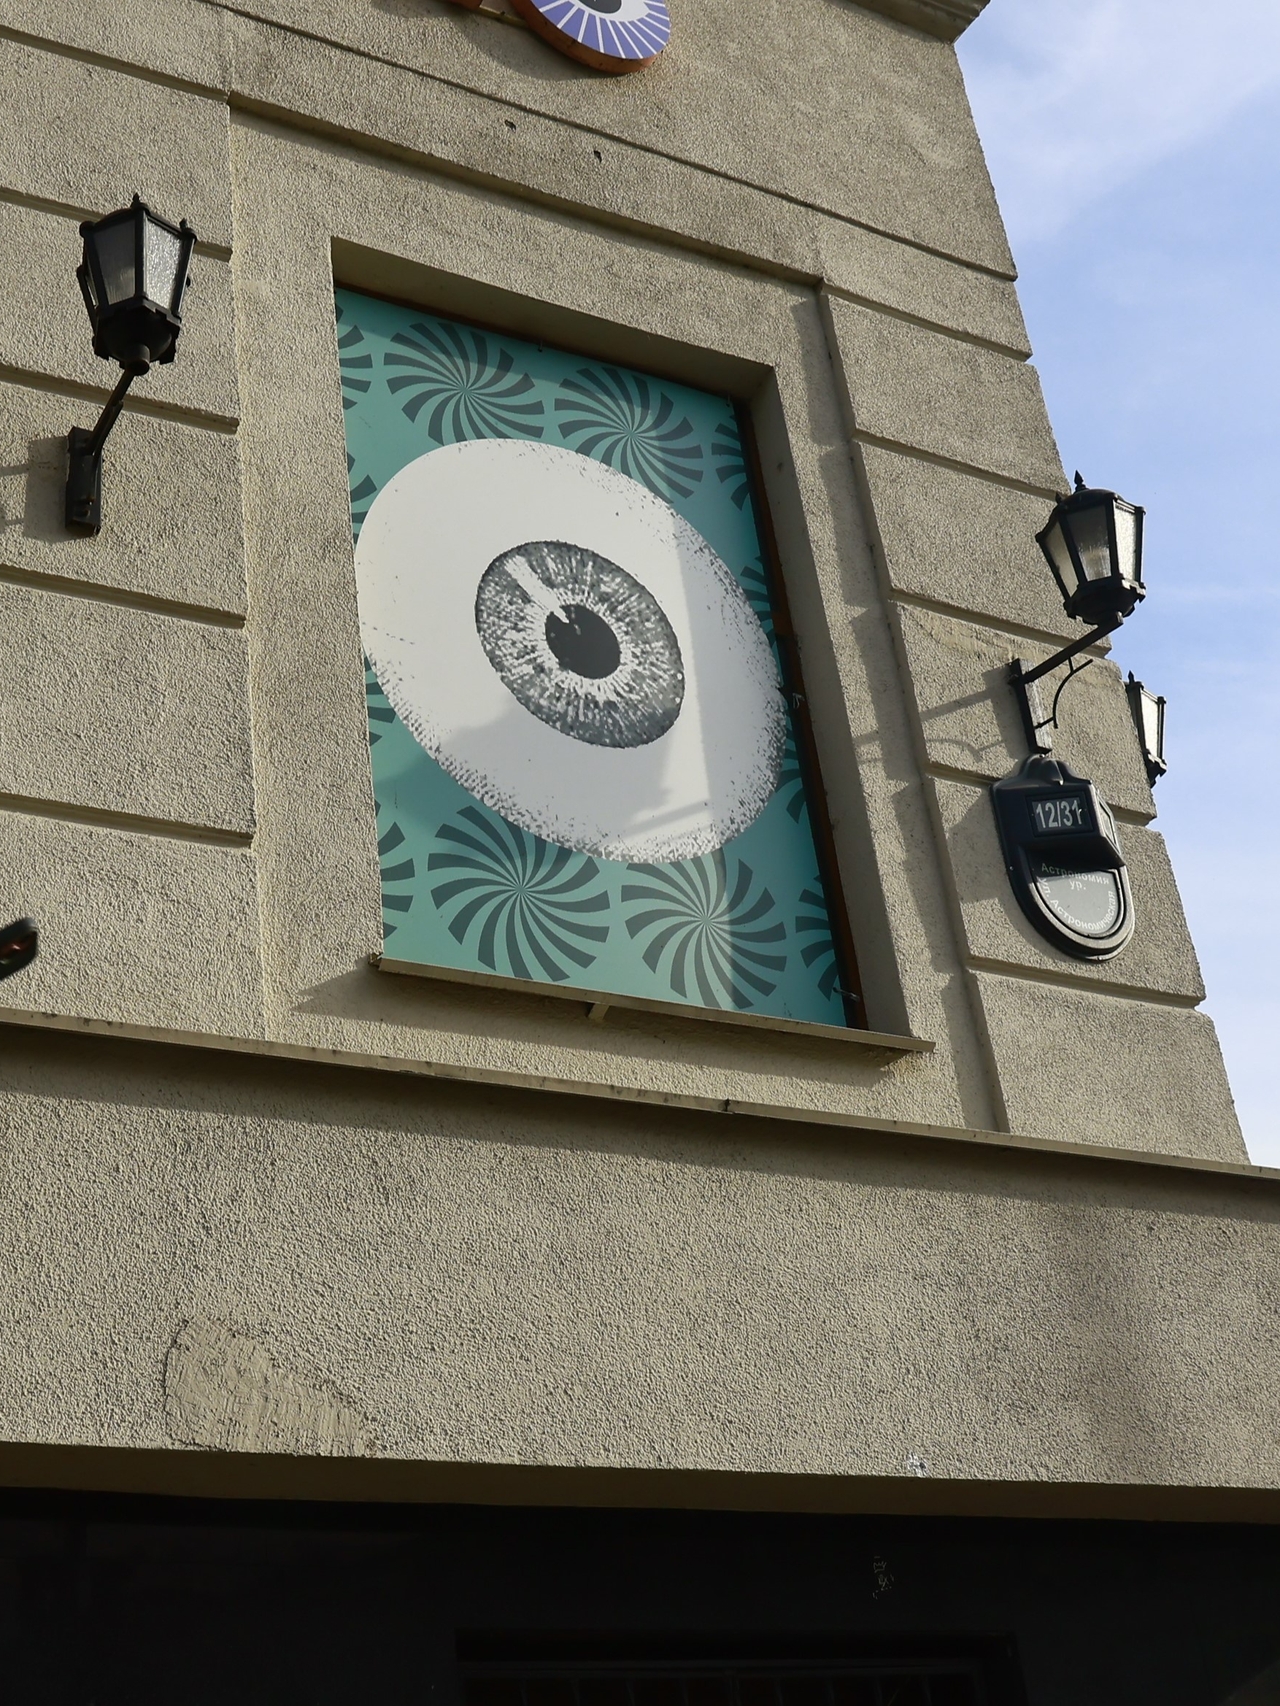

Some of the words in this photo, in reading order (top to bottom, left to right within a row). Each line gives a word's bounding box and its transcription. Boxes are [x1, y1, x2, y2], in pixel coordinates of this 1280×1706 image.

[1036, 799, 1082, 828] 12/31
[1041, 862, 1109, 885] Астрономия
[1069, 879, 1086, 891] ур.
[1036, 876, 1051, 897] ул.
[1051, 890, 1115, 931] Астрономическая
